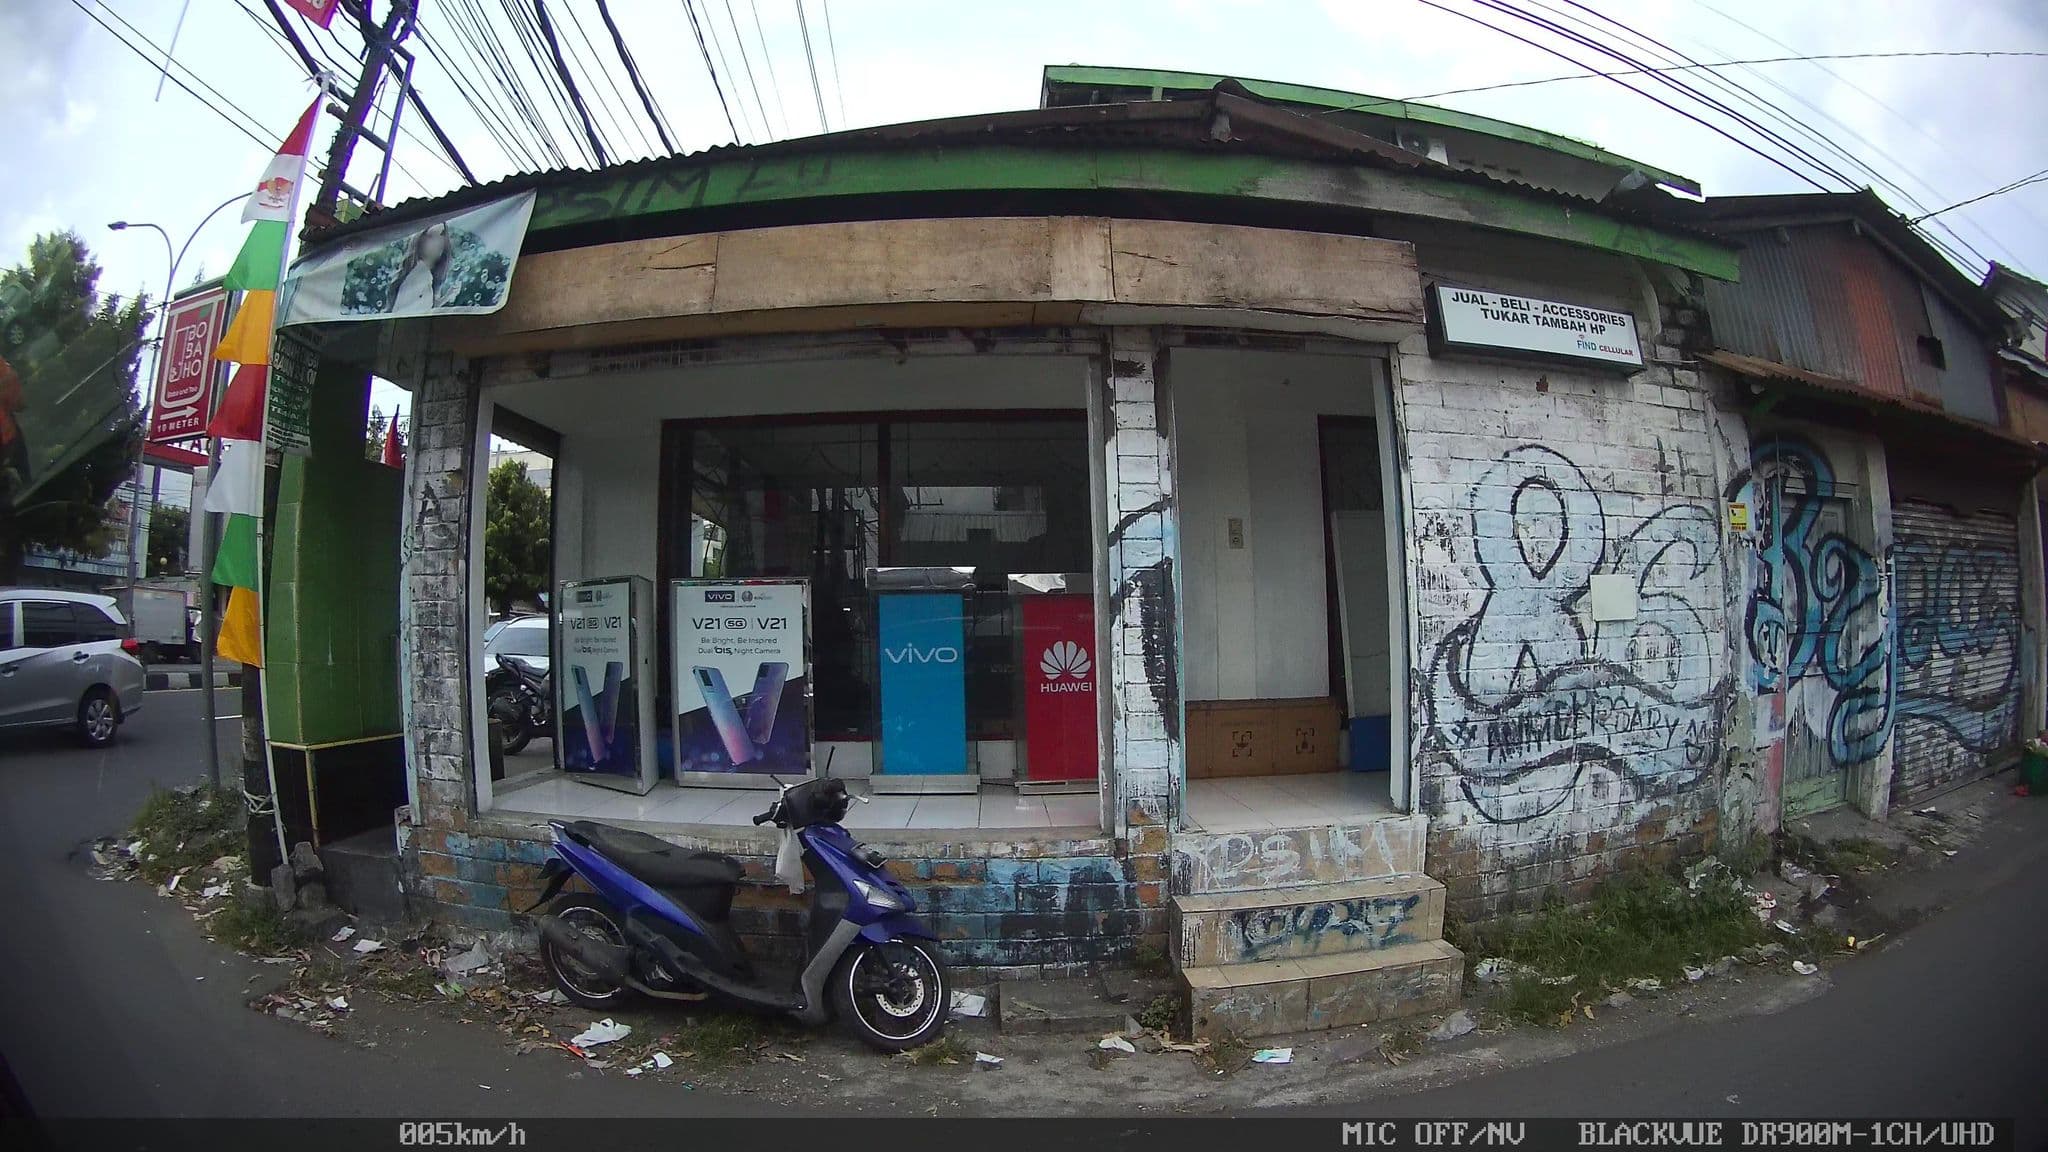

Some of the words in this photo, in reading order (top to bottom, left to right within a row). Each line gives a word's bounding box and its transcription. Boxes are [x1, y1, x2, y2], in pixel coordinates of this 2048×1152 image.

[1452, 292, 1488, 306] JUAL
[1500, 298, 1530, 311] BELI
[1542, 304, 1626, 327] ACCESSORIES
[1480, 308, 1530, 324] TUKAR
[1532, 314, 1586, 333] TAMBAH
[1590, 323, 1606, 336] HP
[189, 322, 207, 340] BO
[186, 342, 202, 359] BA
[1576, 340, 1597, 352] FIND
[1599, 344, 1634, 356] CELLULAR
[182, 360, 201, 378] HO
[168, 417, 199, 431] METER
[570, 616, 586, 630] V21
[604, 616, 622, 629] V21
[692, 618, 720, 630] V21
[758, 618, 786, 630] V21
[1040, 682, 1092, 692] HUAWEI
